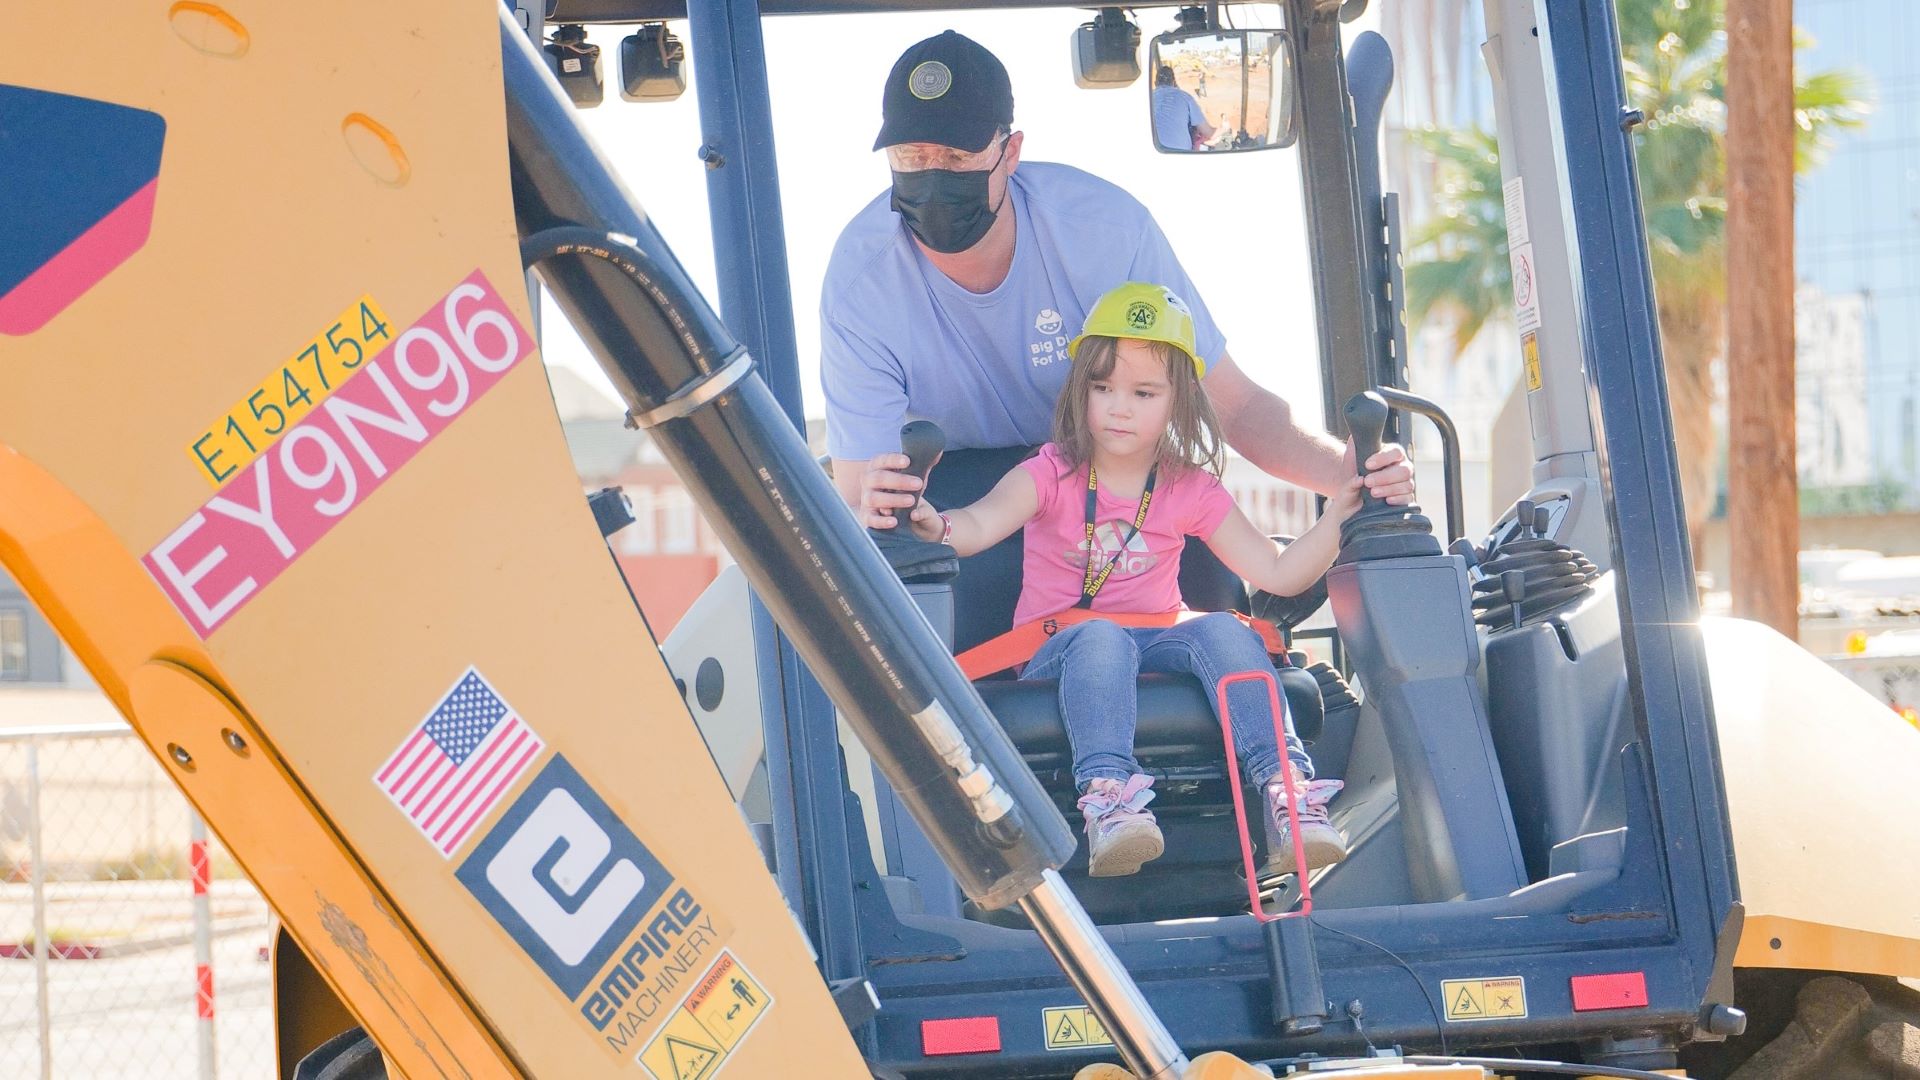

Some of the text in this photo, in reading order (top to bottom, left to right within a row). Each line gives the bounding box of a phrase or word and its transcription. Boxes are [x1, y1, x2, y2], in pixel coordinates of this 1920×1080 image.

[1030, 333, 1071, 354] Big Di
[1031, 354, 1053, 367] For
[192, 300, 391, 484] E154754
[150, 282, 519, 629] EY9N96
[606, 914, 717, 1054] MACHINERY
[697, 958, 732, 999] WARNING
